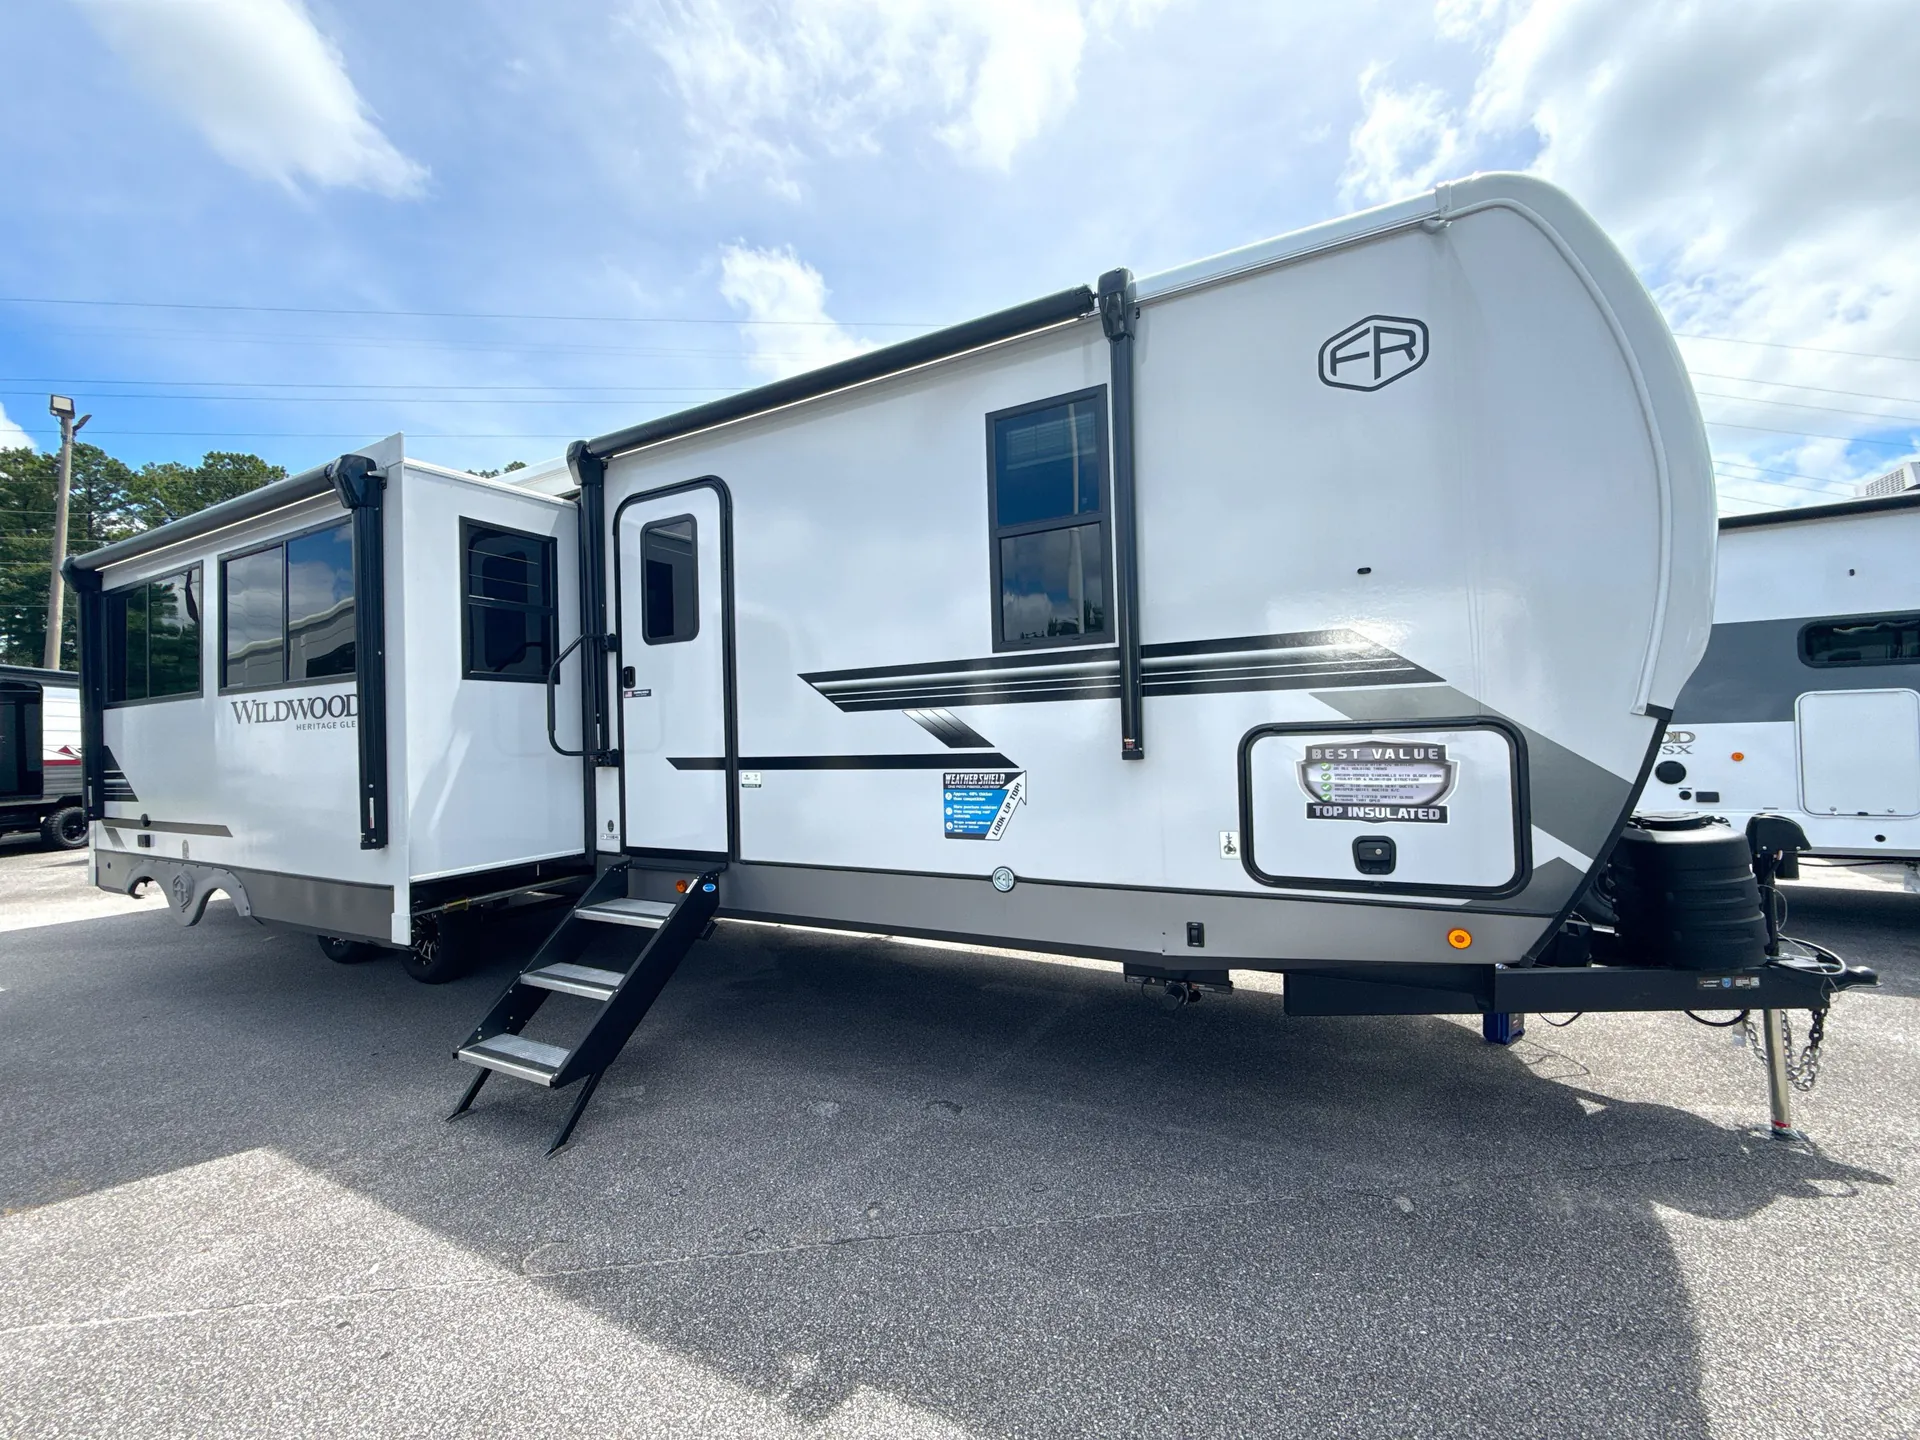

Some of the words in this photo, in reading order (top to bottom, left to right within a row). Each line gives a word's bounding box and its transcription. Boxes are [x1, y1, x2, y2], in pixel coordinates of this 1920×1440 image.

[296, 722, 337, 731] HERITAGE
[340, 721, 356, 729] GLE
[1311, 748, 1361, 760] BEST
[1371, 748, 1439, 760] VALUE
[992, 816, 1006, 836] LOOK
[1003, 802, 1012, 814] UP
[1009, 782, 1022, 801] TOP!
[1313, 805, 1343, 817] TOP
[1347, 806, 1441, 820] INSULATED
